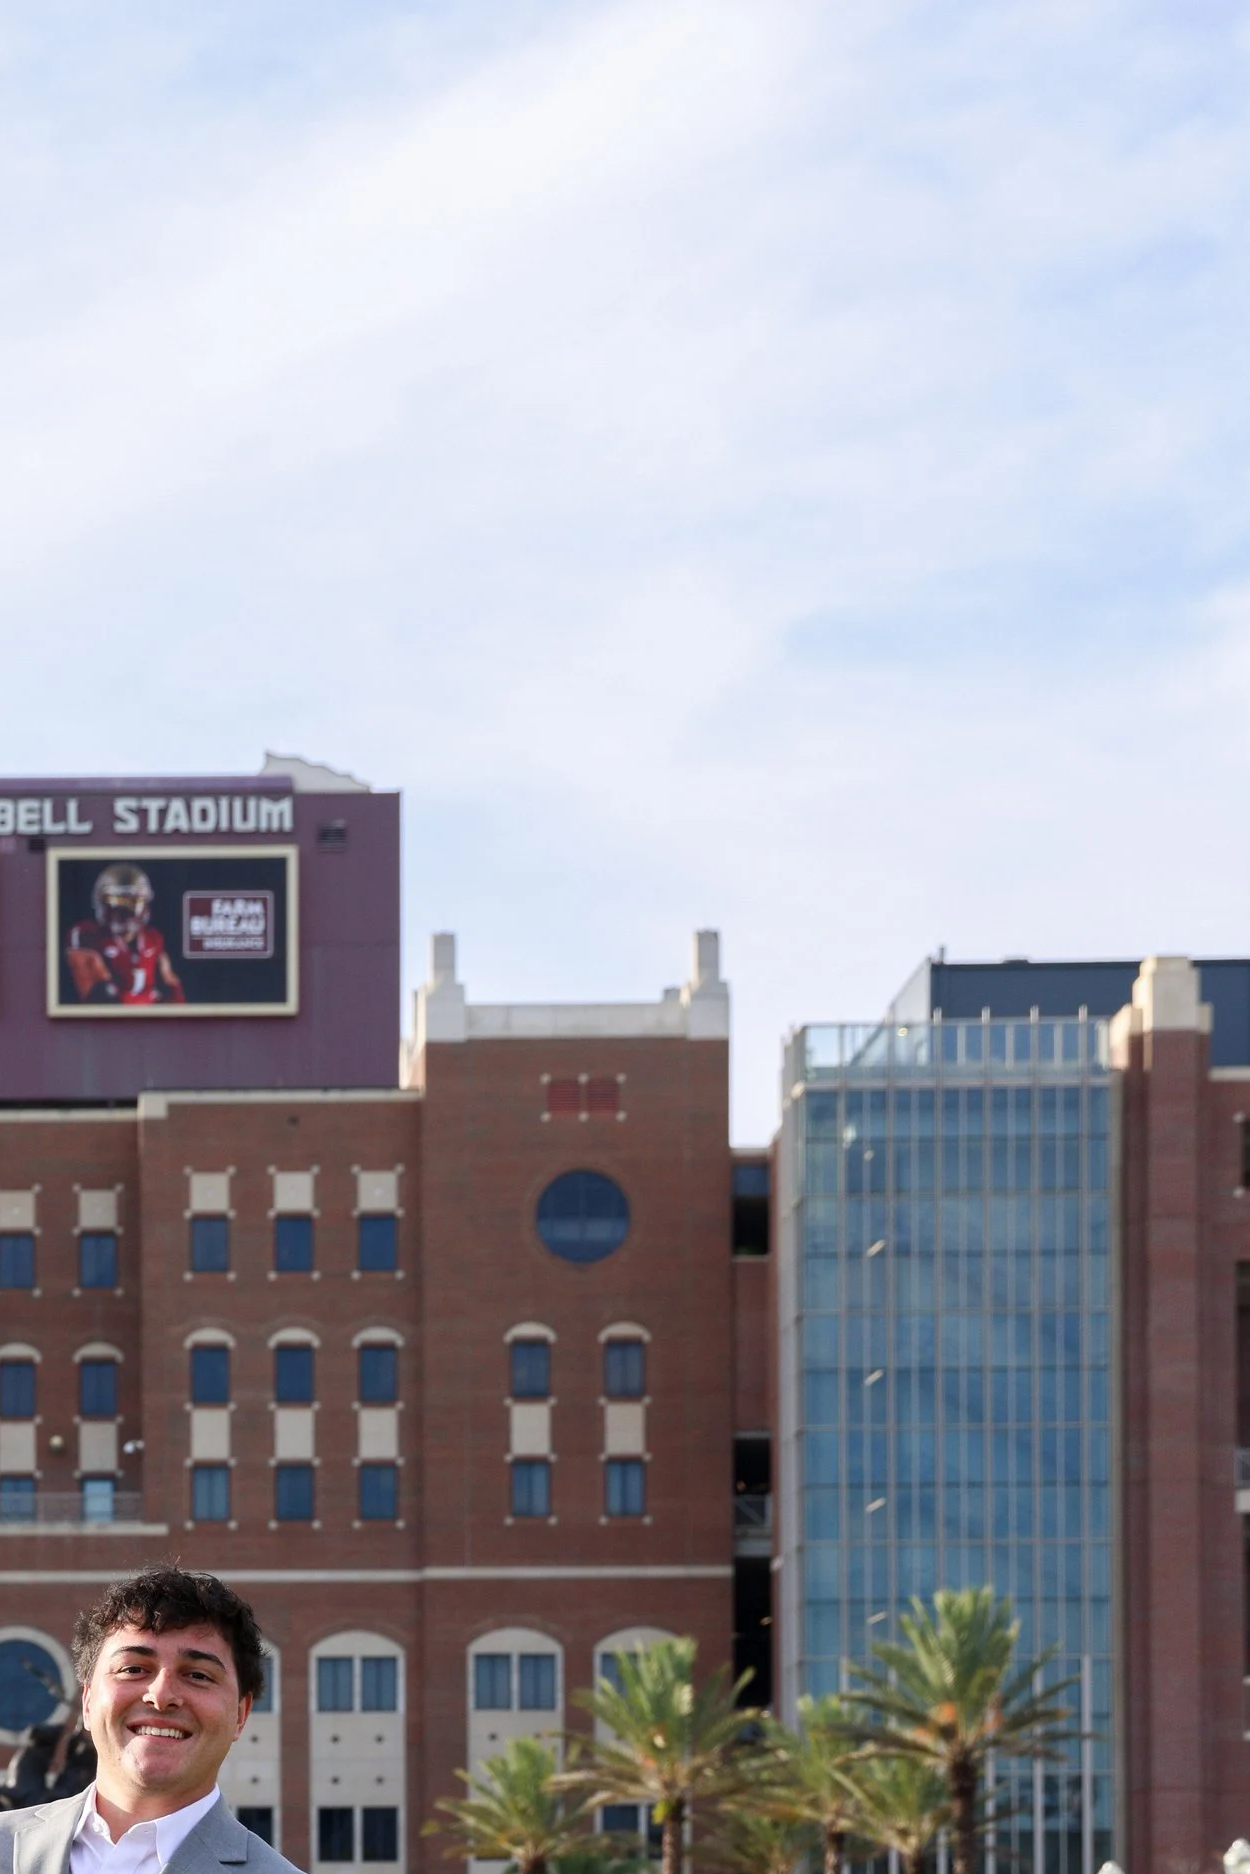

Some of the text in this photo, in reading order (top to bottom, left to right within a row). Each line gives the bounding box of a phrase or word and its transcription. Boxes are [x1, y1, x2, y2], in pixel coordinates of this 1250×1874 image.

[113, 796, 293, 833] STADIUM
[212, 899, 264, 915] FARM
[191, 915, 265, 935] BUREAU
